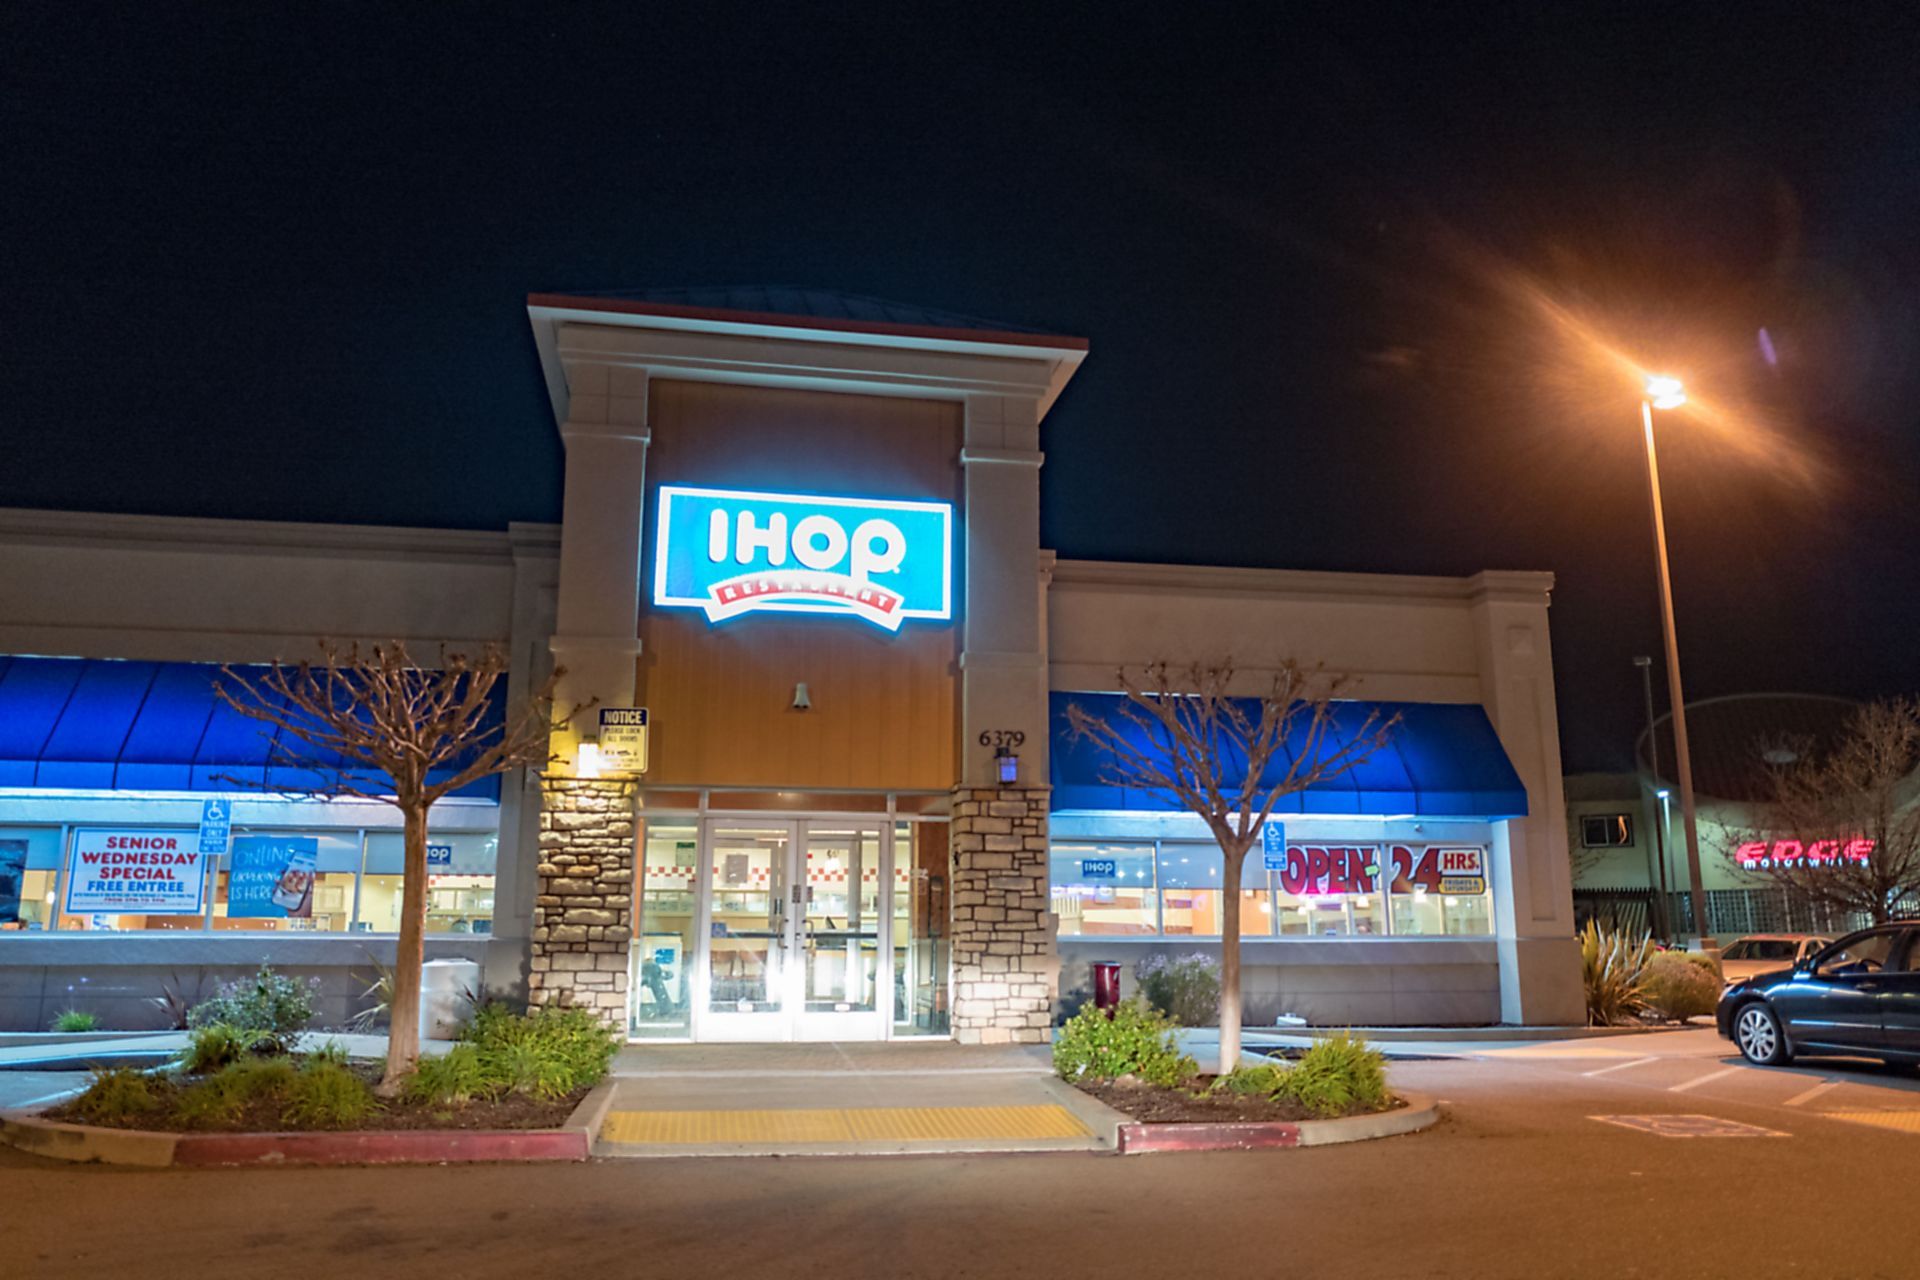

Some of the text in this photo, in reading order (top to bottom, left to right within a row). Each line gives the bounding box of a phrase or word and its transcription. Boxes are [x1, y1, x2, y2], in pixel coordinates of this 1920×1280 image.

[708, 508, 907, 582] IHOP
[604, 711, 643, 723] NOTICE
[979, 730, 1025, 747] 6379
[106, 836, 178, 850] SENIOR
[82, 851, 198, 865] WEDNESDAY
[235, 843, 293, 867] ONLINE
[1735, 839, 1875, 864] EDGE
[99, 866, 175, 880] SPECIAL
[1084, 862, 1113, 874] IHOP
[1281, 846, 1479, 895] OPEN 24 HRS.
[87, 880, 184, 892] FREE ENTREE
[231, 885, 272, 901] IS HERE
